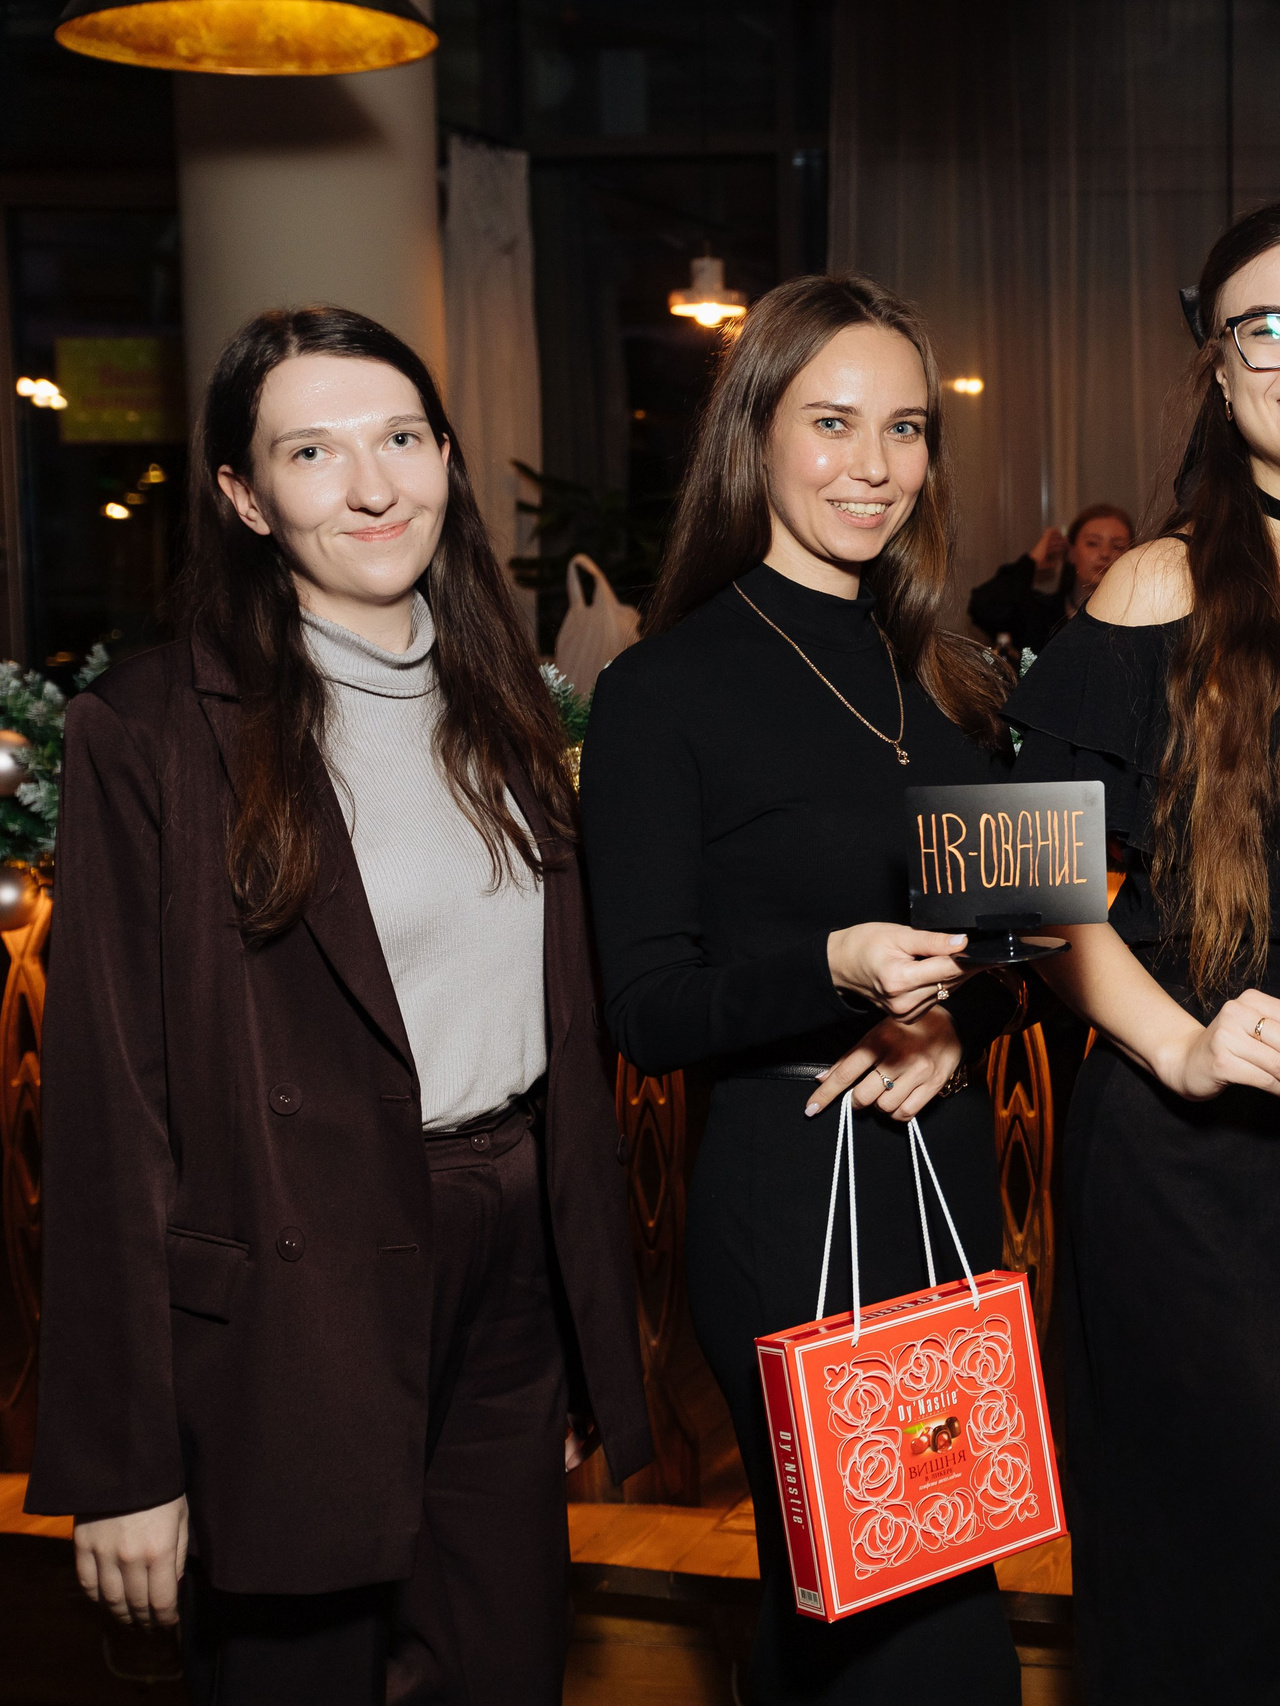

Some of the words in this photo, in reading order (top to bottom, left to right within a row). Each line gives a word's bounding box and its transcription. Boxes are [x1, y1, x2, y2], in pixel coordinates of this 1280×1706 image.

[917, 810, 1087, 895] HR-ОВАНИЕ
[897, 1390, 958, 1423] Dy'Nastie
[779, 1431, 803, 1524] Dy'Nastie
[908, 1450, 967, 1480] ВИШНЯ
